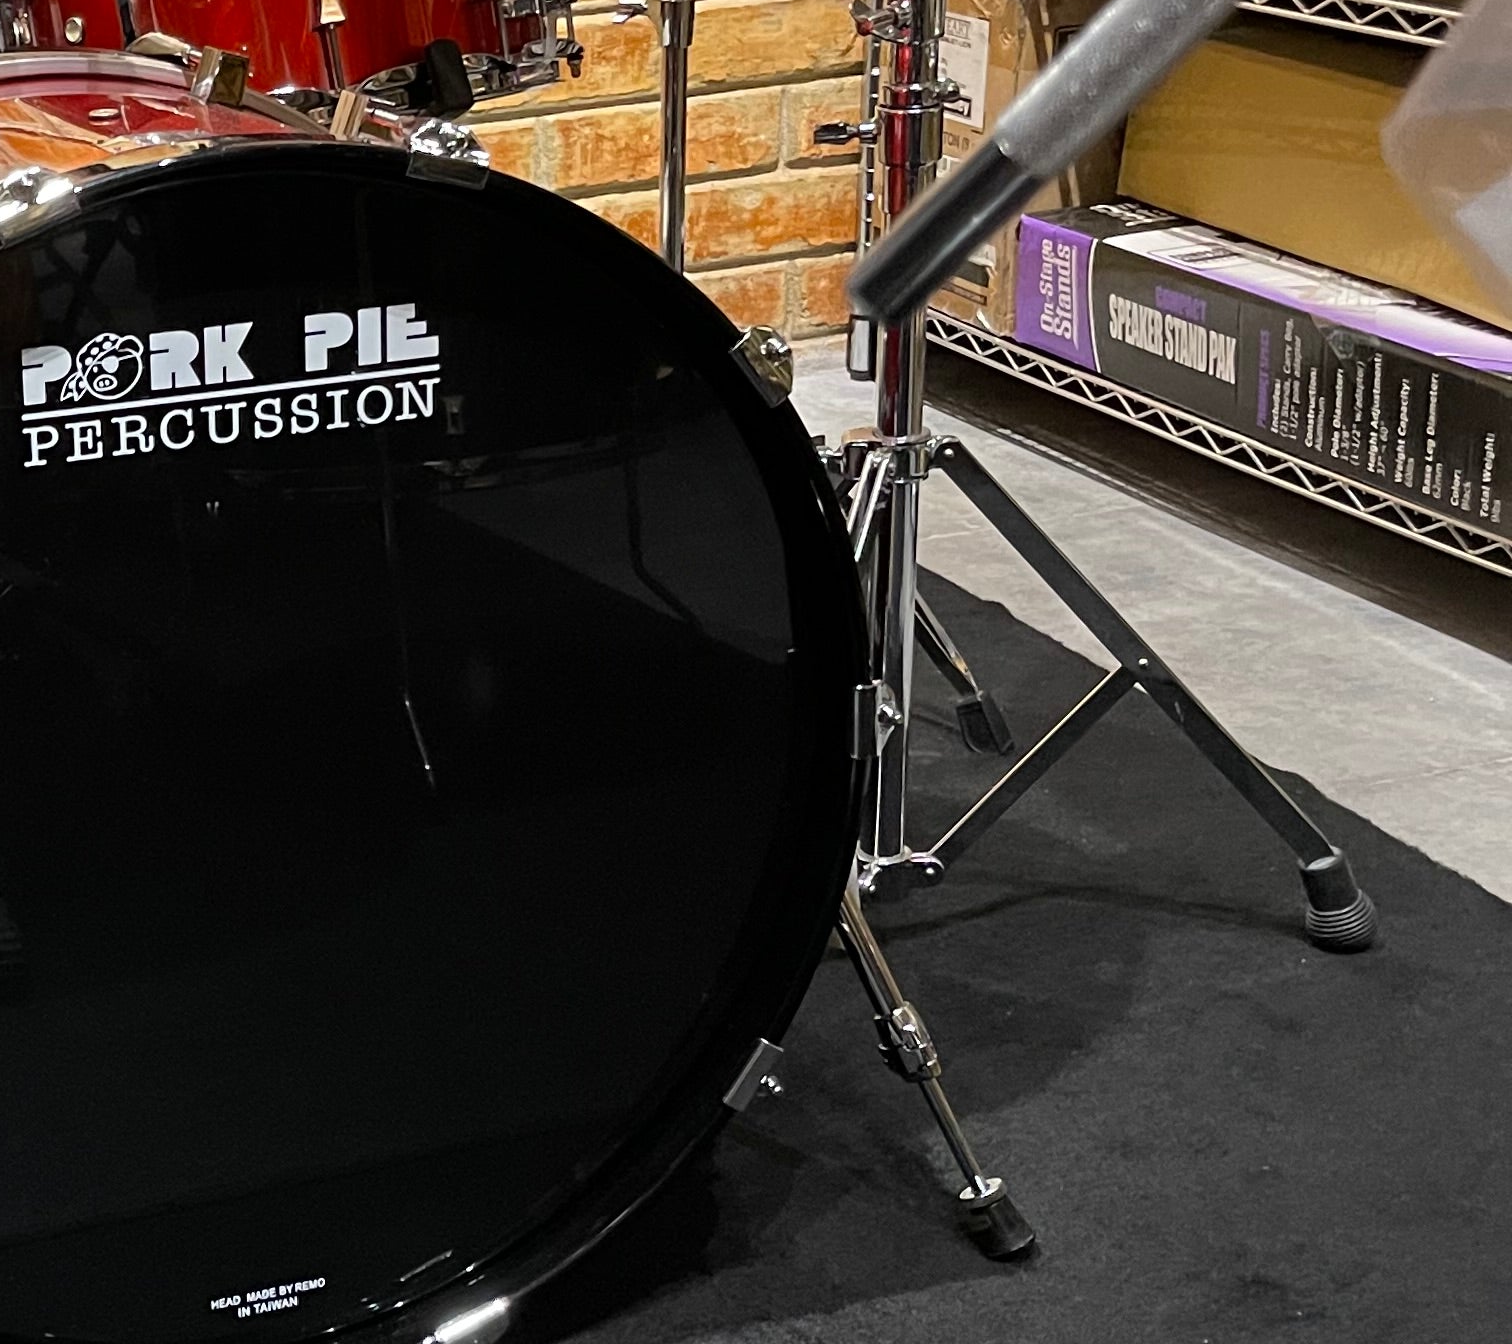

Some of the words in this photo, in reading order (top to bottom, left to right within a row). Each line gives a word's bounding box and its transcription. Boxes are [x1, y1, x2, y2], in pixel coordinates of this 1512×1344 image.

[1040, 238, 1056, 334] On-Stage
[1053, 243, 1073, 340] Stands
[21, 322, 254, 406] PORK
[304, 302, 440, 372] PIE
[1109, 293, 1164, 356] SPEAKER
[1164, 313, 1207, 373] STAND
[1208, 330, 1237, 385] PAK
[22, 377, 441, 468] PERCUSSION
[1331, 431, 1340, 458] Pole
[1367, 432, 1378, 472] Height
[1394, 439, 1406, 483] Weight
[1424, 439, 1435, 461] Leg
[1422, 464, 1432, 495] Base
[1479, 487, 1490, 517] Total
[210, 1295, 241, 1310] HEAD
[246, 1287, 277, 1303] MADE
[279, 1284, 294, 1296] BY
[294, 1277, 326, 1293] REMO
[238, 1307, 250, 1318] IN
[253, 1296, 298, 1314] TAIWAN
